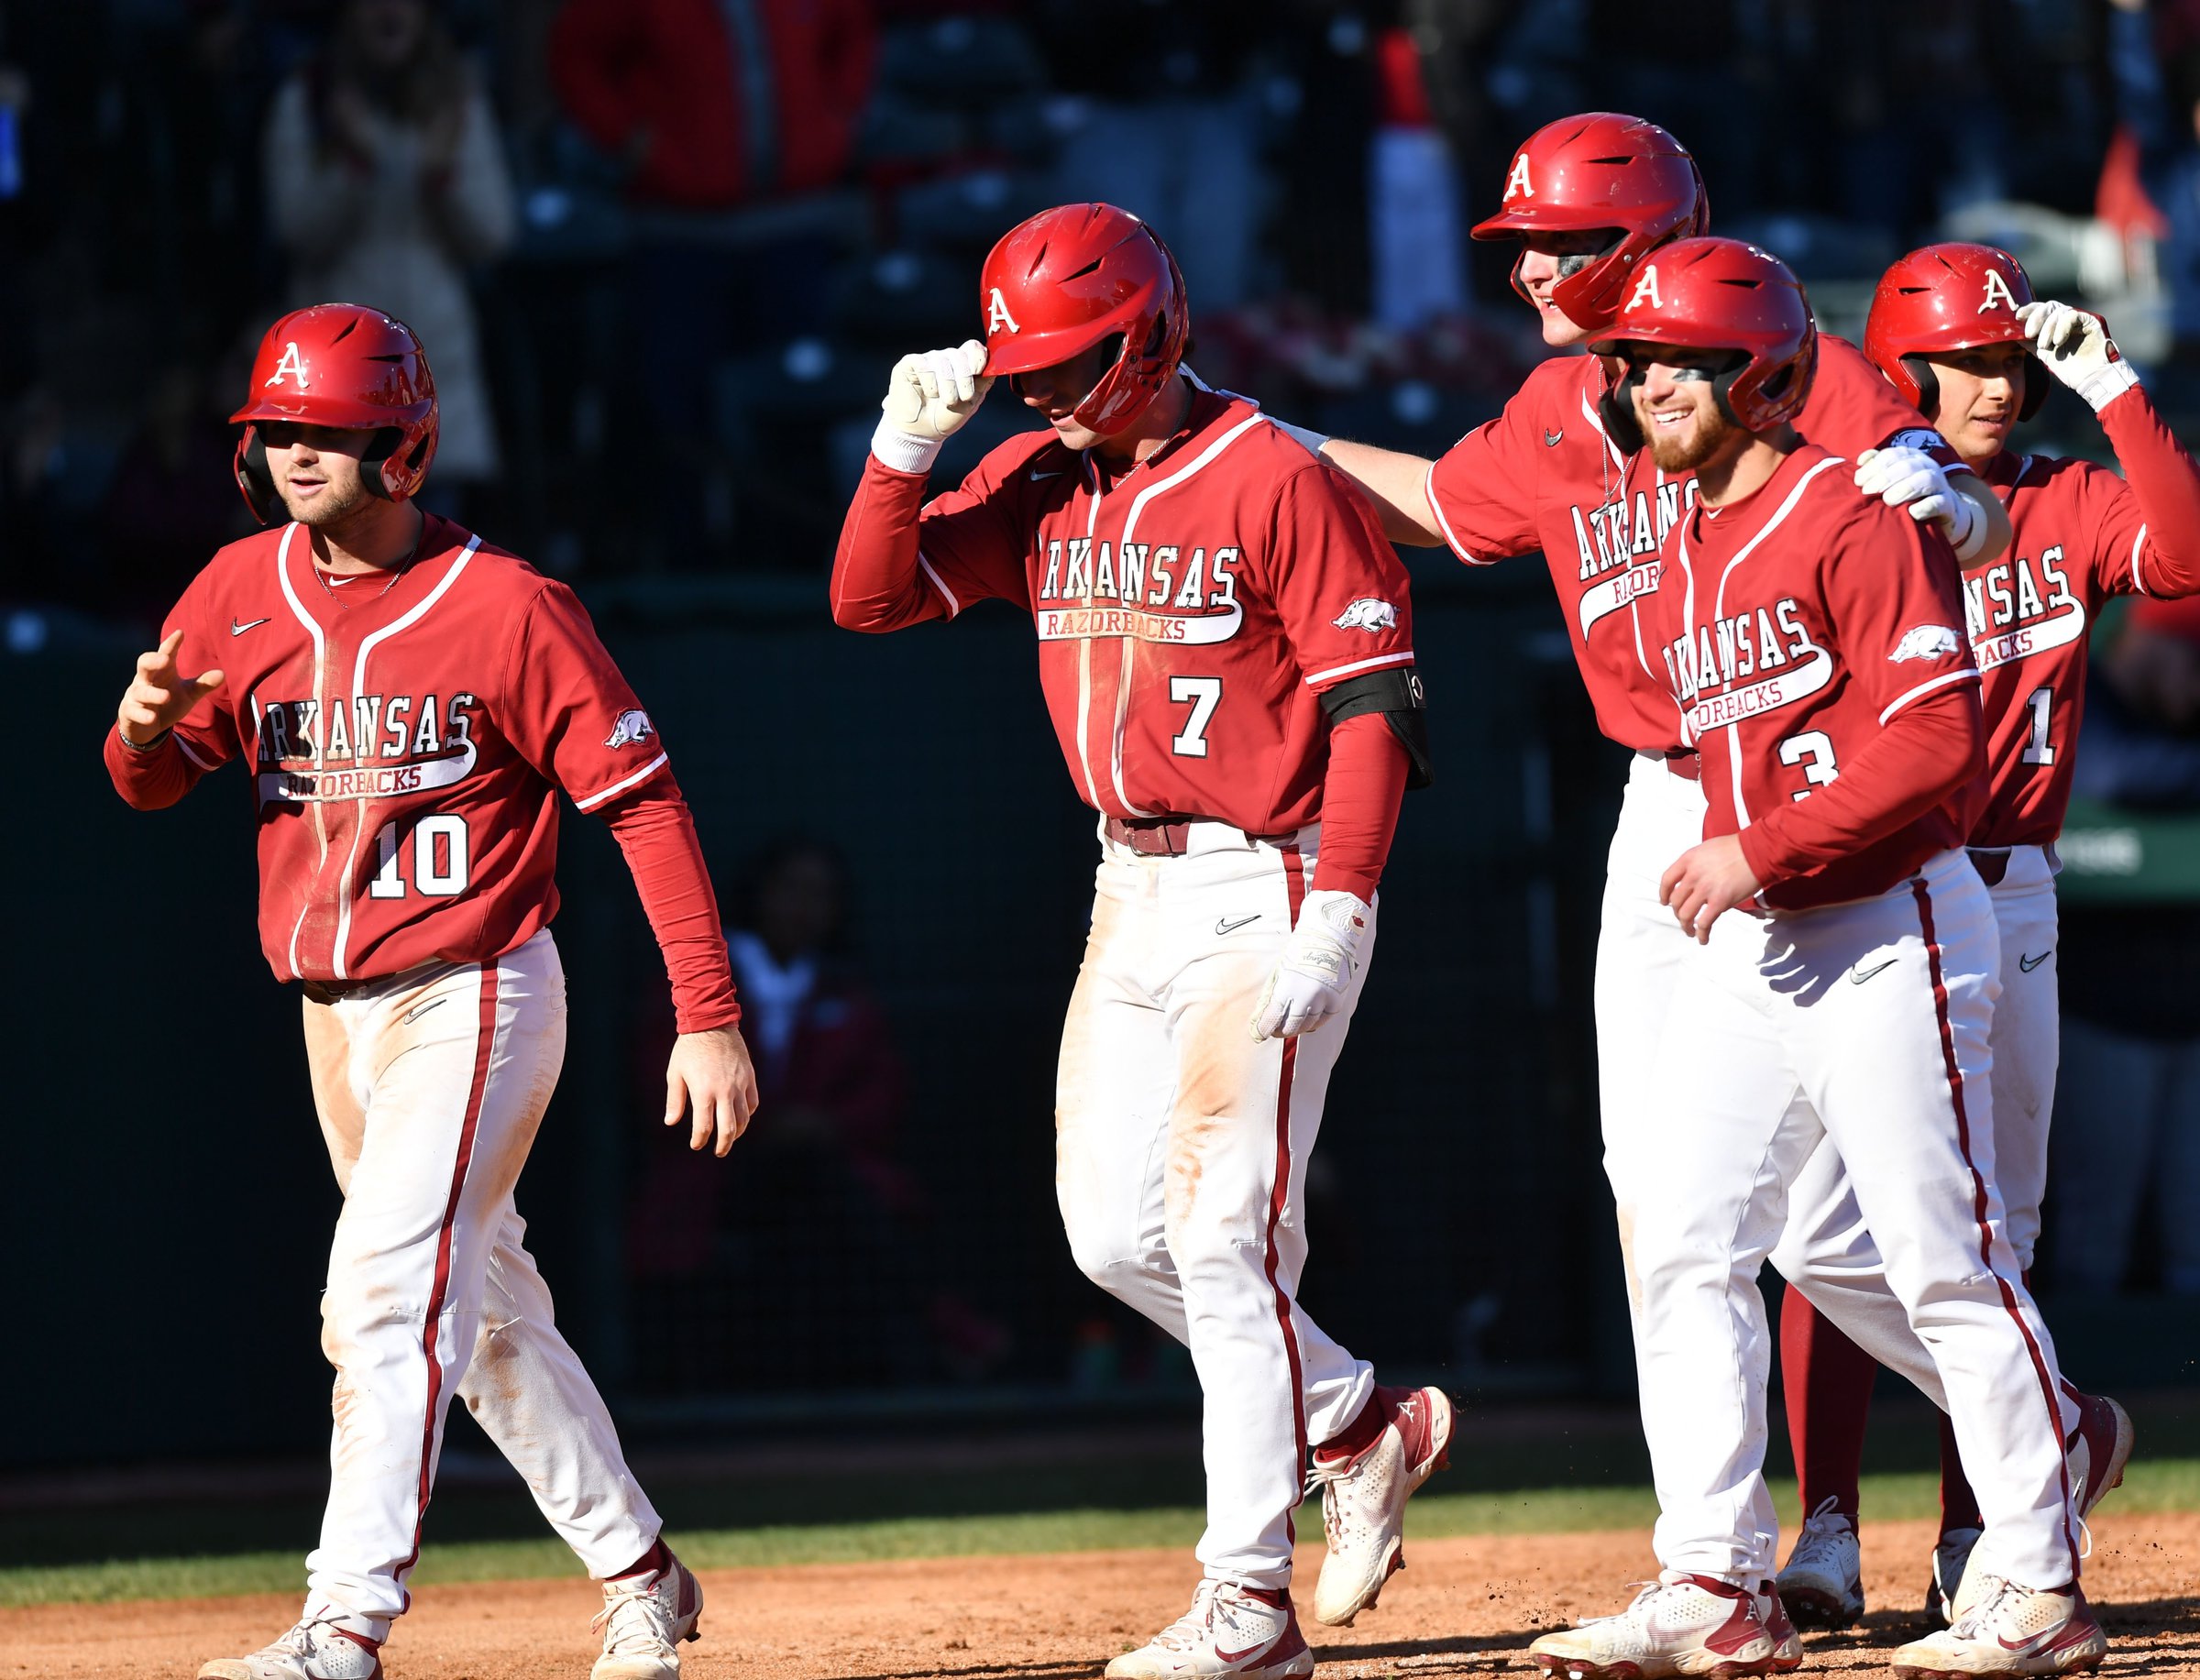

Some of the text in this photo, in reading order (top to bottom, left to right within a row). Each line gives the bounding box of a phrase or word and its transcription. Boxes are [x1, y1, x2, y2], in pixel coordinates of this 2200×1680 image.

[1502, 152, 1535, 203] A
[987, 287, 1020, 337] A
[1623, 264, 1664, 313] A
[1977, 269, 2018, 314] A
[264, 341, 310, 389] A
[1038, 533, 1239, 609] RKANSAS
[1046, 610, 1186, 640] RAZORBACKS
[1169, 675, 1224, 759] 7
[2021, 686, 2056, 766] 1
[286, 766, 423, 799] RAZORBACKS
[1776, 730, 1841, 804] 3
[368, 813, 469, 900] 10
